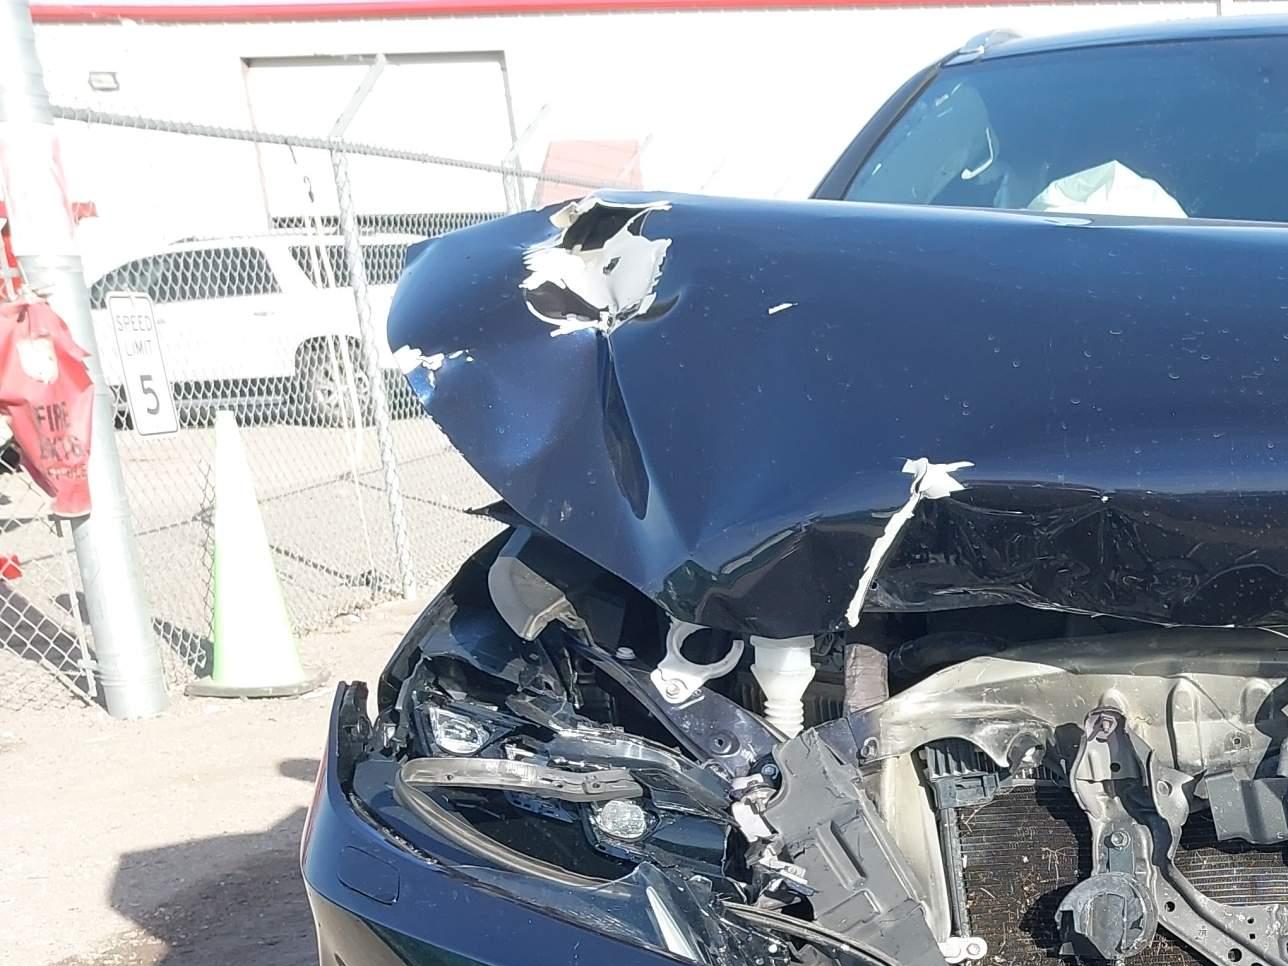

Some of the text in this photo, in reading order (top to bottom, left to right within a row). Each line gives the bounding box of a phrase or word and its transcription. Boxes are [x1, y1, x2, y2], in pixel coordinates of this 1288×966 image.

[116, 314, 153, 331] SPEED
[124, 338, 153, 357] LIMIT
[139, 374, 160, 415] 5
